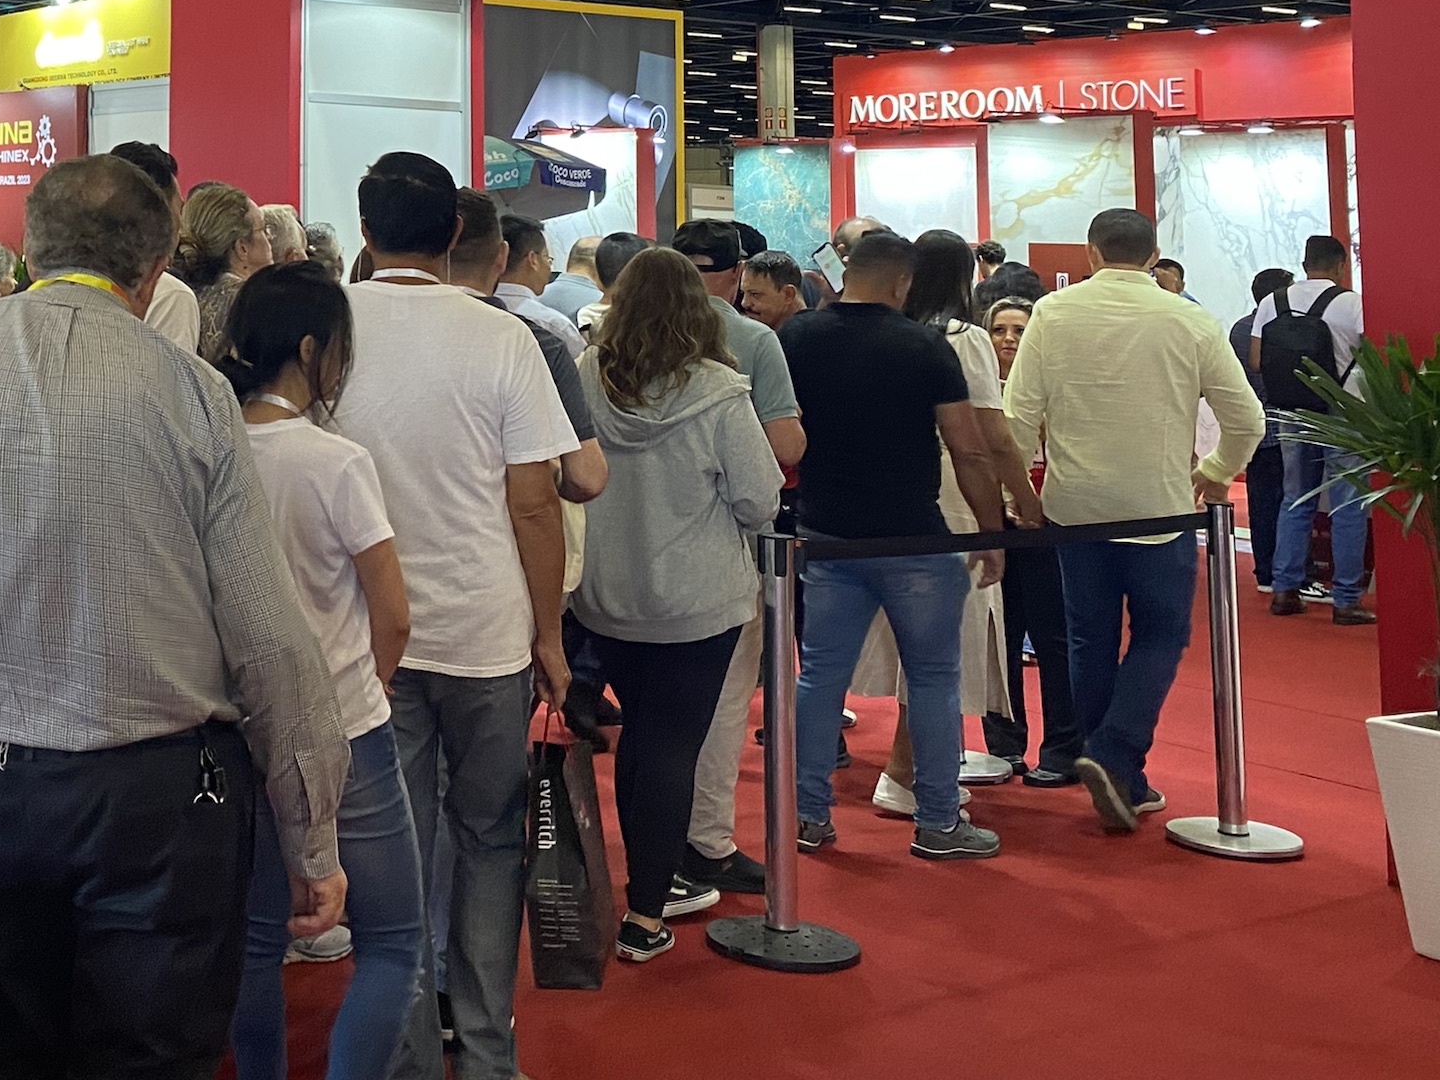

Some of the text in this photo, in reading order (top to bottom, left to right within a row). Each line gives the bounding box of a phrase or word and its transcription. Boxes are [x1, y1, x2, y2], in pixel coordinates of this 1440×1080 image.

[849, 77, 1185, 124] MOREROOM STONE
[17, 174, 31, 185] 2023
[537, 778, 557, 851] everrich
